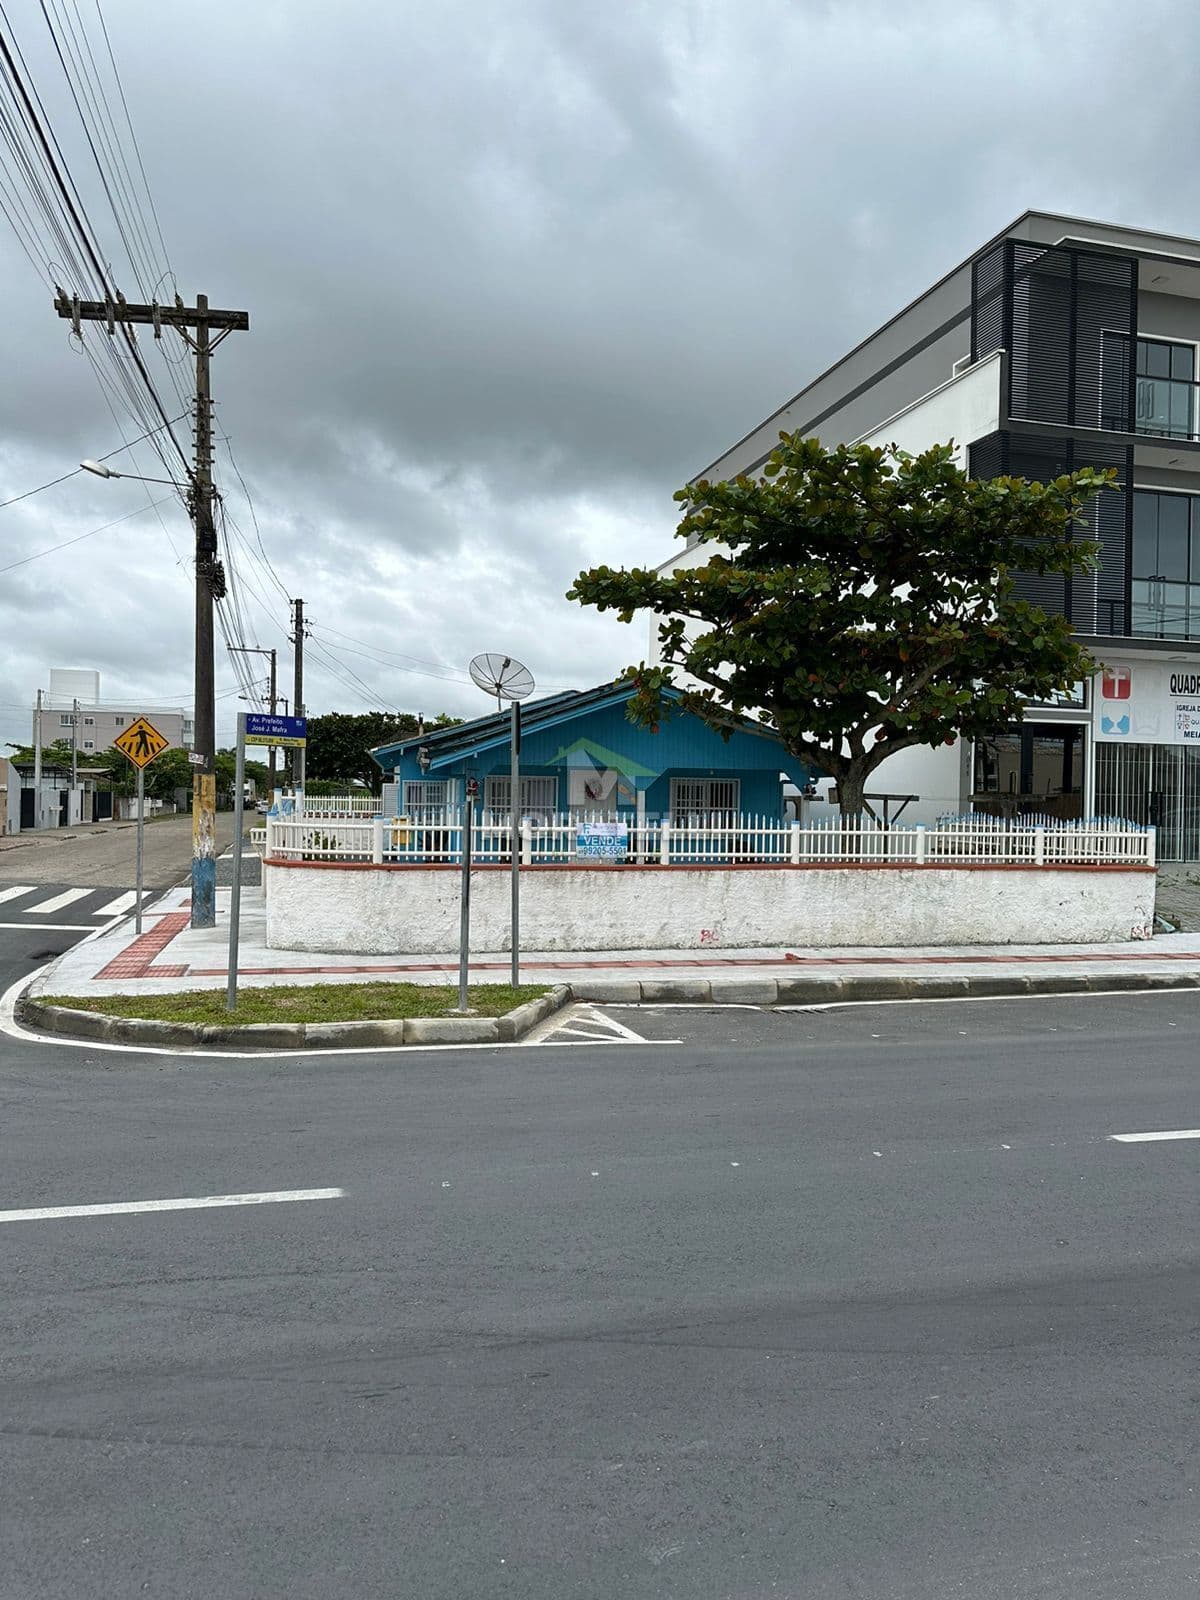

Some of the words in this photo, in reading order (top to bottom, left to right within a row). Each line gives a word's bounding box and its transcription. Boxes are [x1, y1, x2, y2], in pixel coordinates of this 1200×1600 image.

[1177, 704, 1196, 712] IGREJA
[261, 717, 283, 725] Prefeito
[272, 726, 288, 734] Mafra
[583, 836, 622, 846] VENDE
